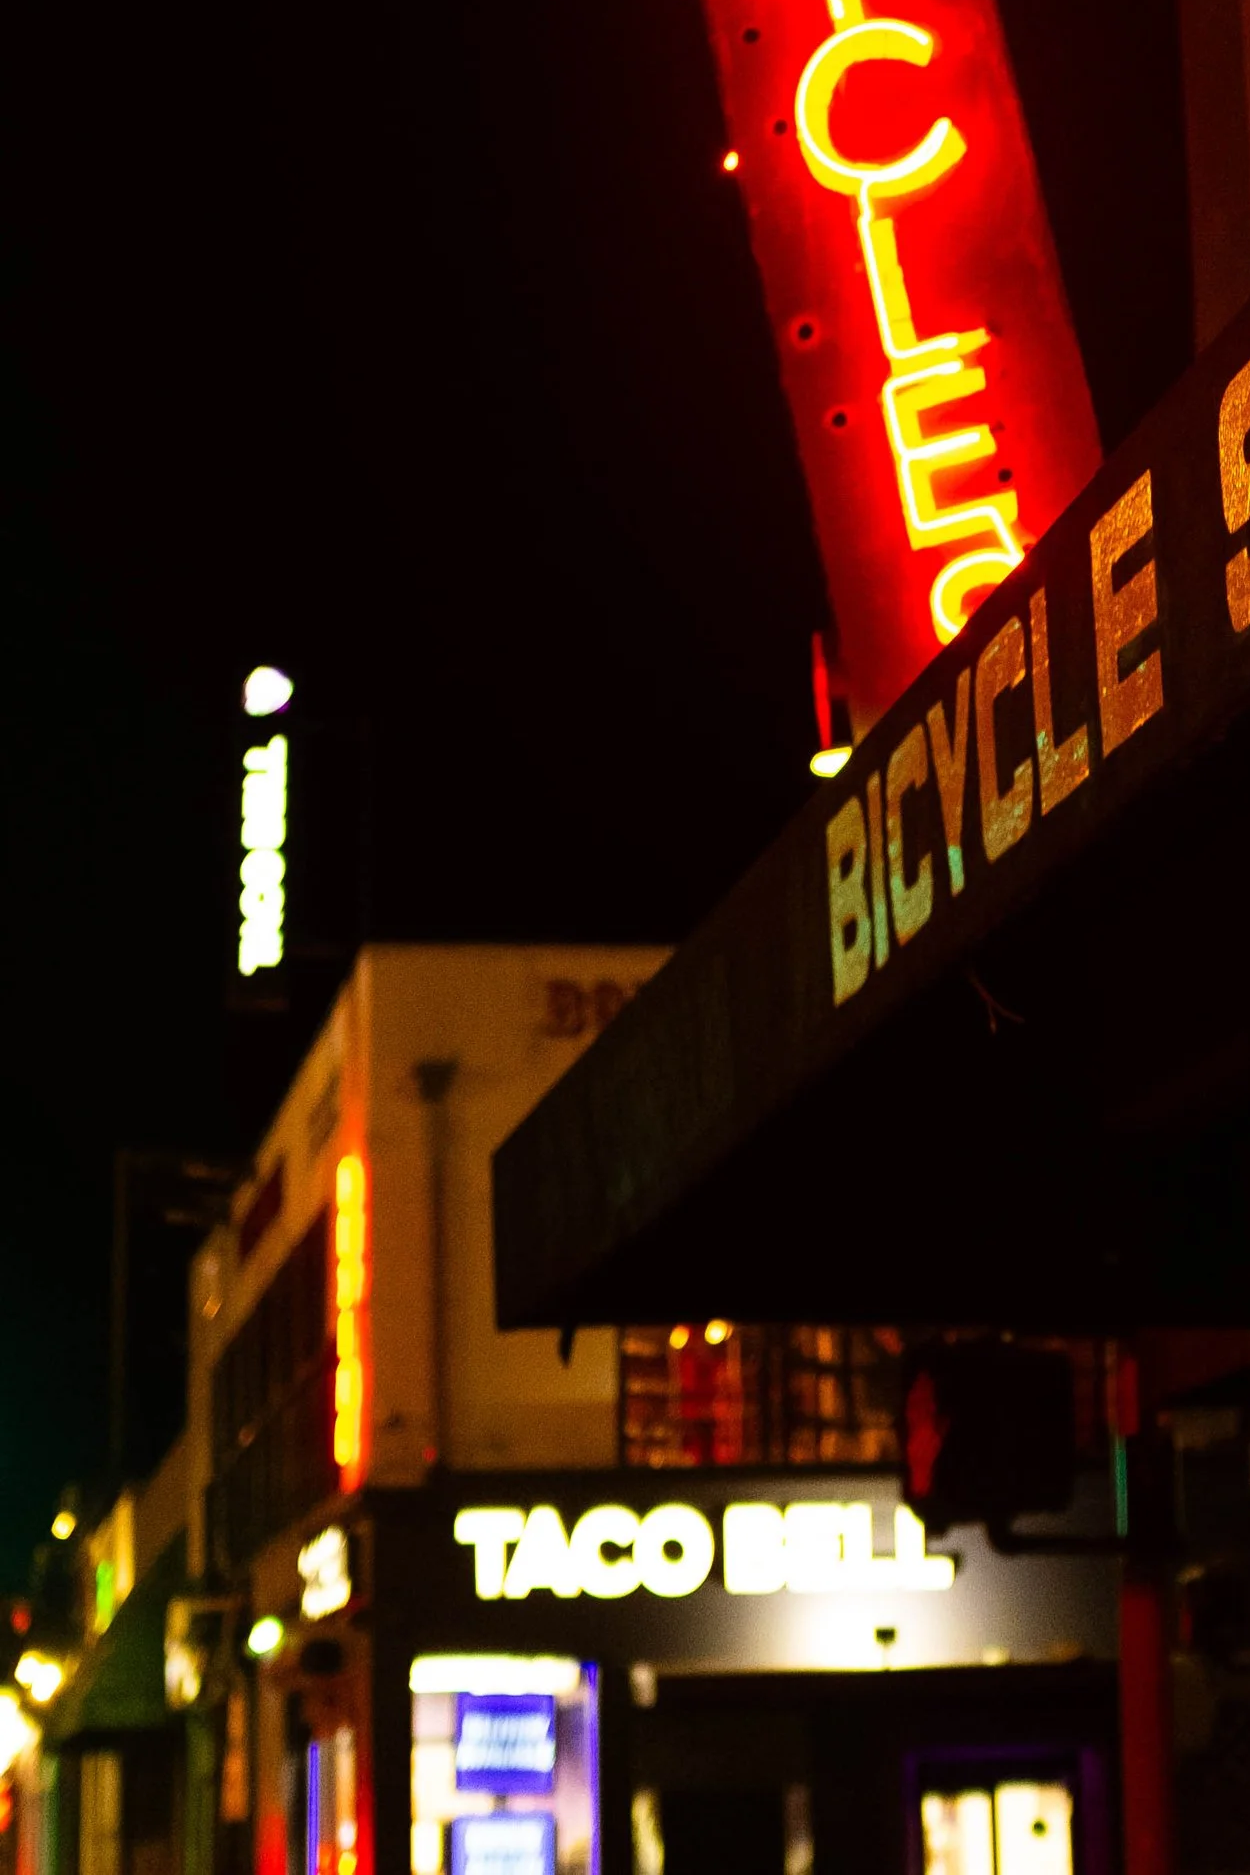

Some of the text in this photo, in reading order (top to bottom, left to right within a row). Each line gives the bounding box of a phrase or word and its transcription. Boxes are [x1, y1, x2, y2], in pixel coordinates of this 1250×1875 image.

[825, 467, 1164, 1008] BICYCLE
[454, 1502, 715, 1600] TACO
[722, 1501, 957, 1596] BELL
